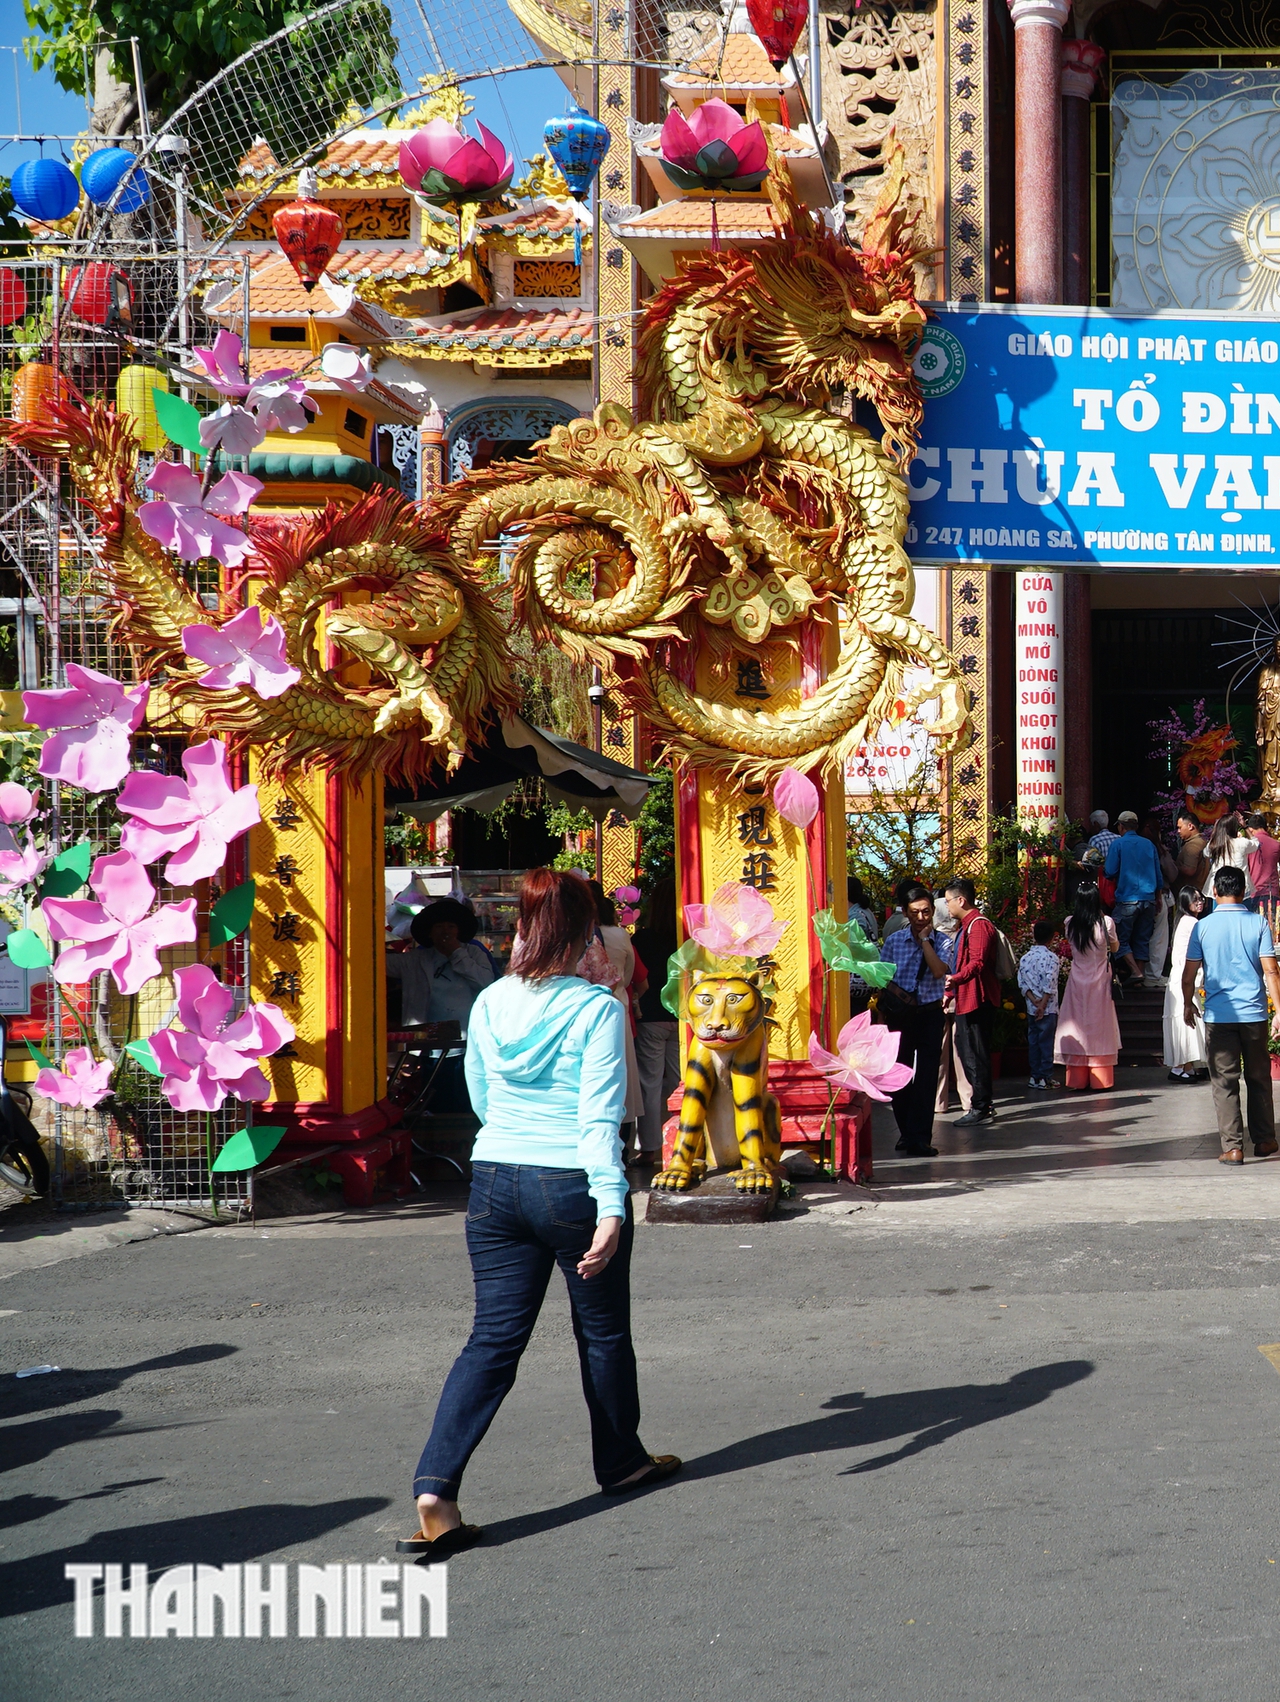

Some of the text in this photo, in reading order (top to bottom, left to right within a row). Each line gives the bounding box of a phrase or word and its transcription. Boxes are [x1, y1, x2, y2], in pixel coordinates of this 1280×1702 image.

[926, 327, 964, 367] PHẬT GIÁO
[1008, 331, 1073, 357] GIÁO
[1082, 333, 1128, 362] HỘI
[1138, 335, 1207, 365] PHẬT
[1215, 338, 1279, 363] GIÁO
[930, 378, 956, 395] NAM
[1073, 373, 1160, 432] TỔ
[906, 437, 1125, 507] CHÙA
[925, 527, 963, 545] 247
[970, 526, 1040, 547] HOÀNG
[1047, 530, 1078, 549] SA,
[1084, 529, 1169, 550] PHƯỜNG
[1175, 530, 1214, 551] TÂN
[1220, 533, 1275, 555] ĐỊNH,
[1023, 574, 1053, 591] CỬA
[1027, 598, 1047, 614] VÔ
[1018, 624, 1059, 639] MINH,
[1025, 642, 1051, 659] MỞ
[1019, 666, 1058, 682] DÒNG
[1021, 687, 1056, 705] SUỐI
[1020, 714, 1057, 730] NGỌT
[1022, 736, 1056, 750] KHƠI
[847, 766, 887, 777] 2026
[1022, 757, 1055, 773] TÌNH
[1018, 780, 1062, 796] CHÚNG
